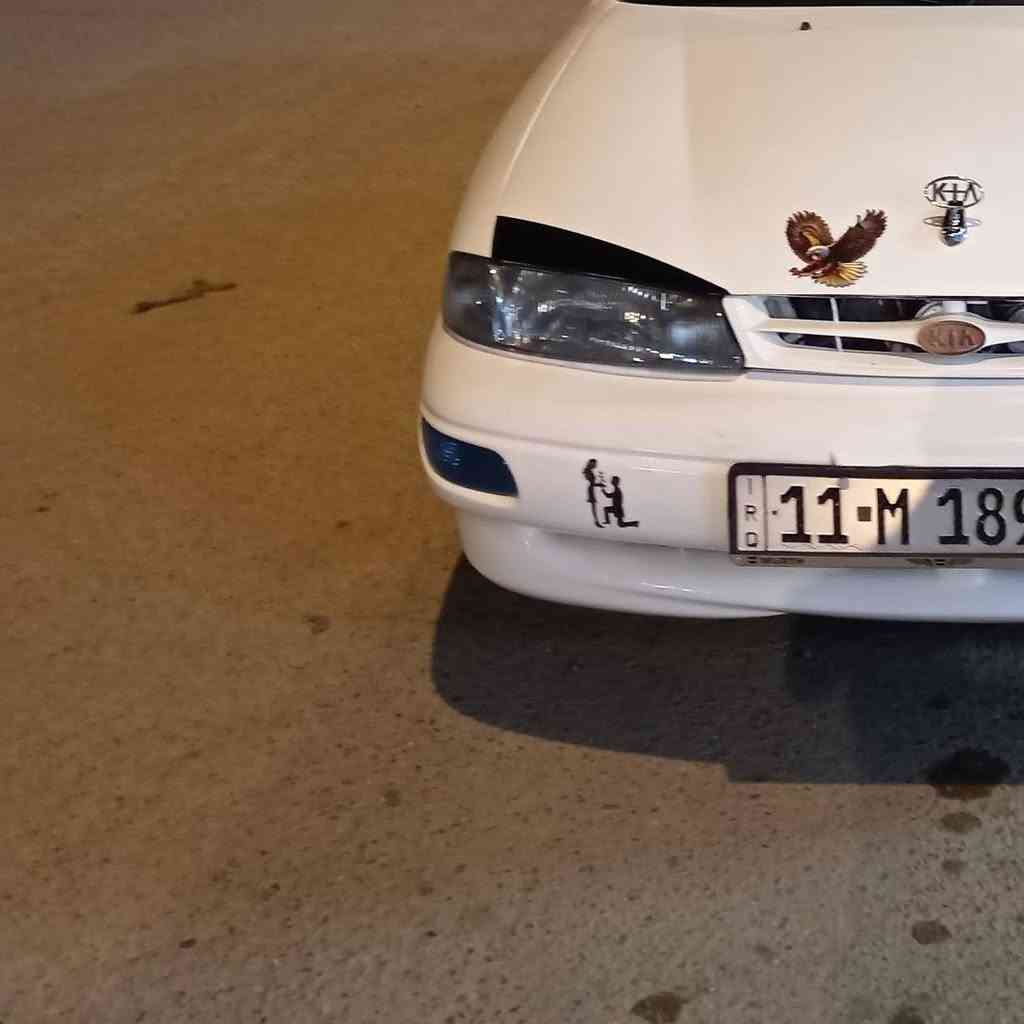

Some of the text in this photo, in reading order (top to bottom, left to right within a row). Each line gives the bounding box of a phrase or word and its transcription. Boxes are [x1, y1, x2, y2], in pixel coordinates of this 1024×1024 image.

[932, 181, 978, 202] KIA
[780, 486, 849, 544] 11
[876, 487, 910, 545] M
